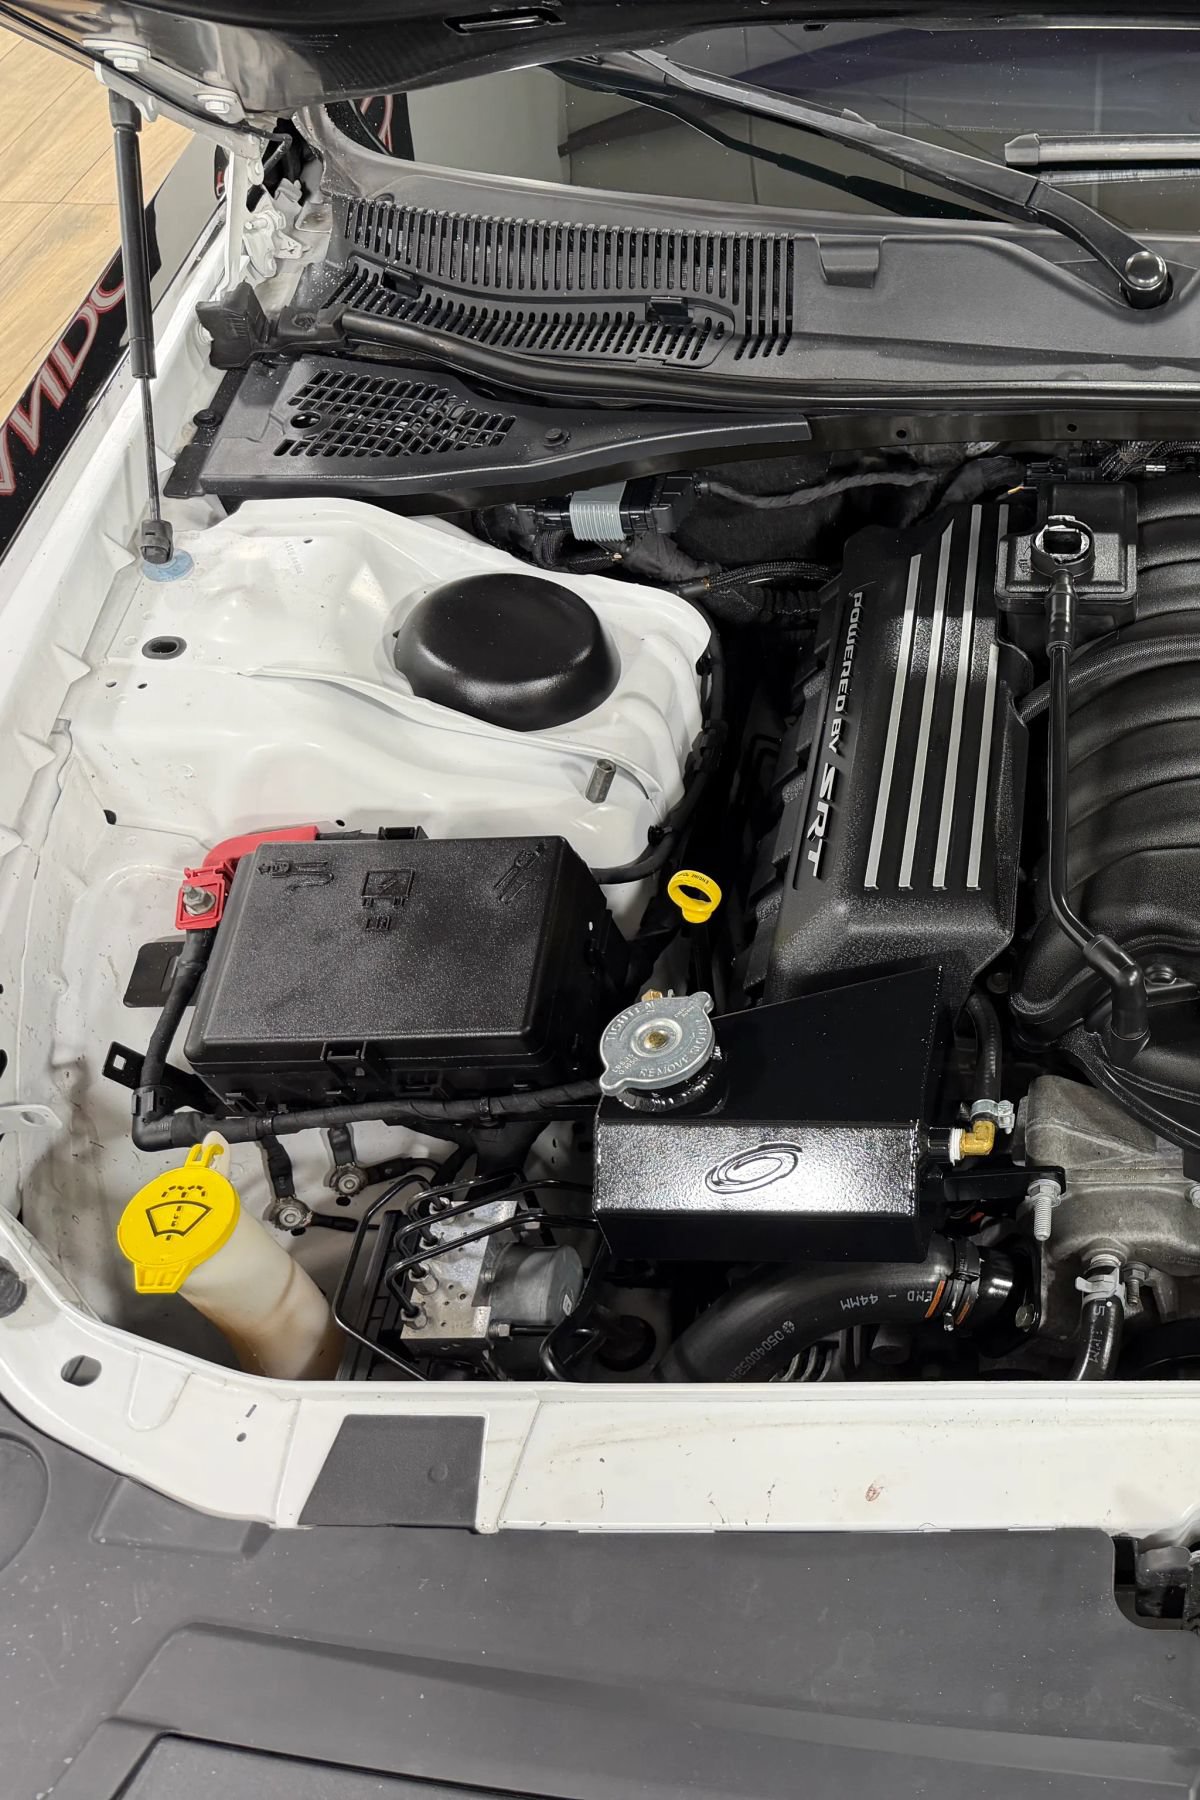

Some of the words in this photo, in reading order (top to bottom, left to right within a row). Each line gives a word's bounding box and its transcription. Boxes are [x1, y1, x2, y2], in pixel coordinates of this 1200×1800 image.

[834, 591, 863, 713] POWERED
[828, 717, 843, 754] BY
[806, 762, 836, 878] SRT
[639, 1054, 690, 1078] REMOVE
[839, 1292, 879, 1312] 44MM
[907, 1289, 934, 1303] END
